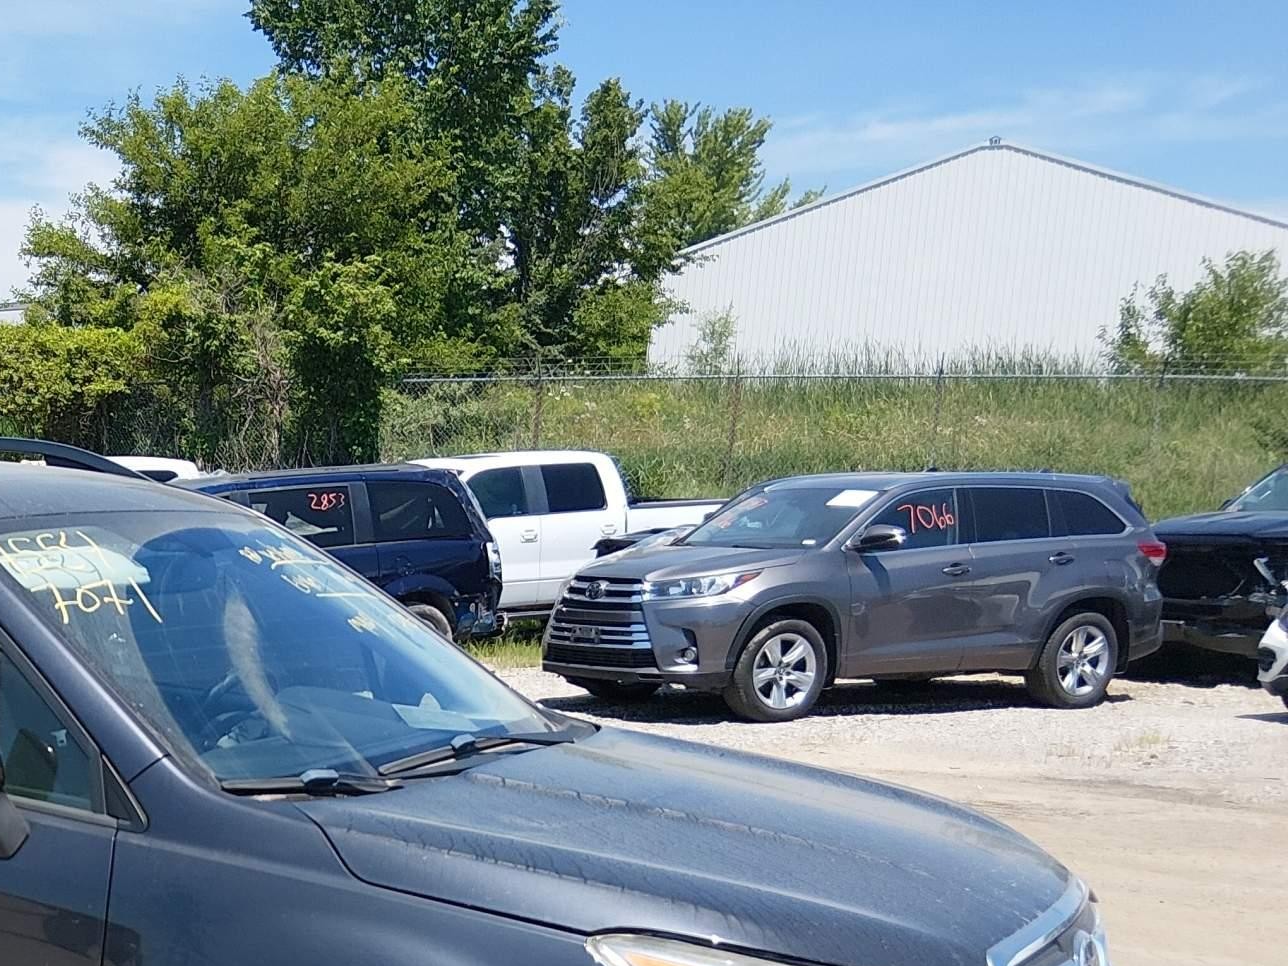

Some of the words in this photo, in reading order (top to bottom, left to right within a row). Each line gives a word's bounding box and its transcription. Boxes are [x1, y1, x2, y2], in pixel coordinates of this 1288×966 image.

[307, 493, 345, 510] 2853
[897, 503, 954, 534] 7066
[30, 577, 163, 625] 7071
